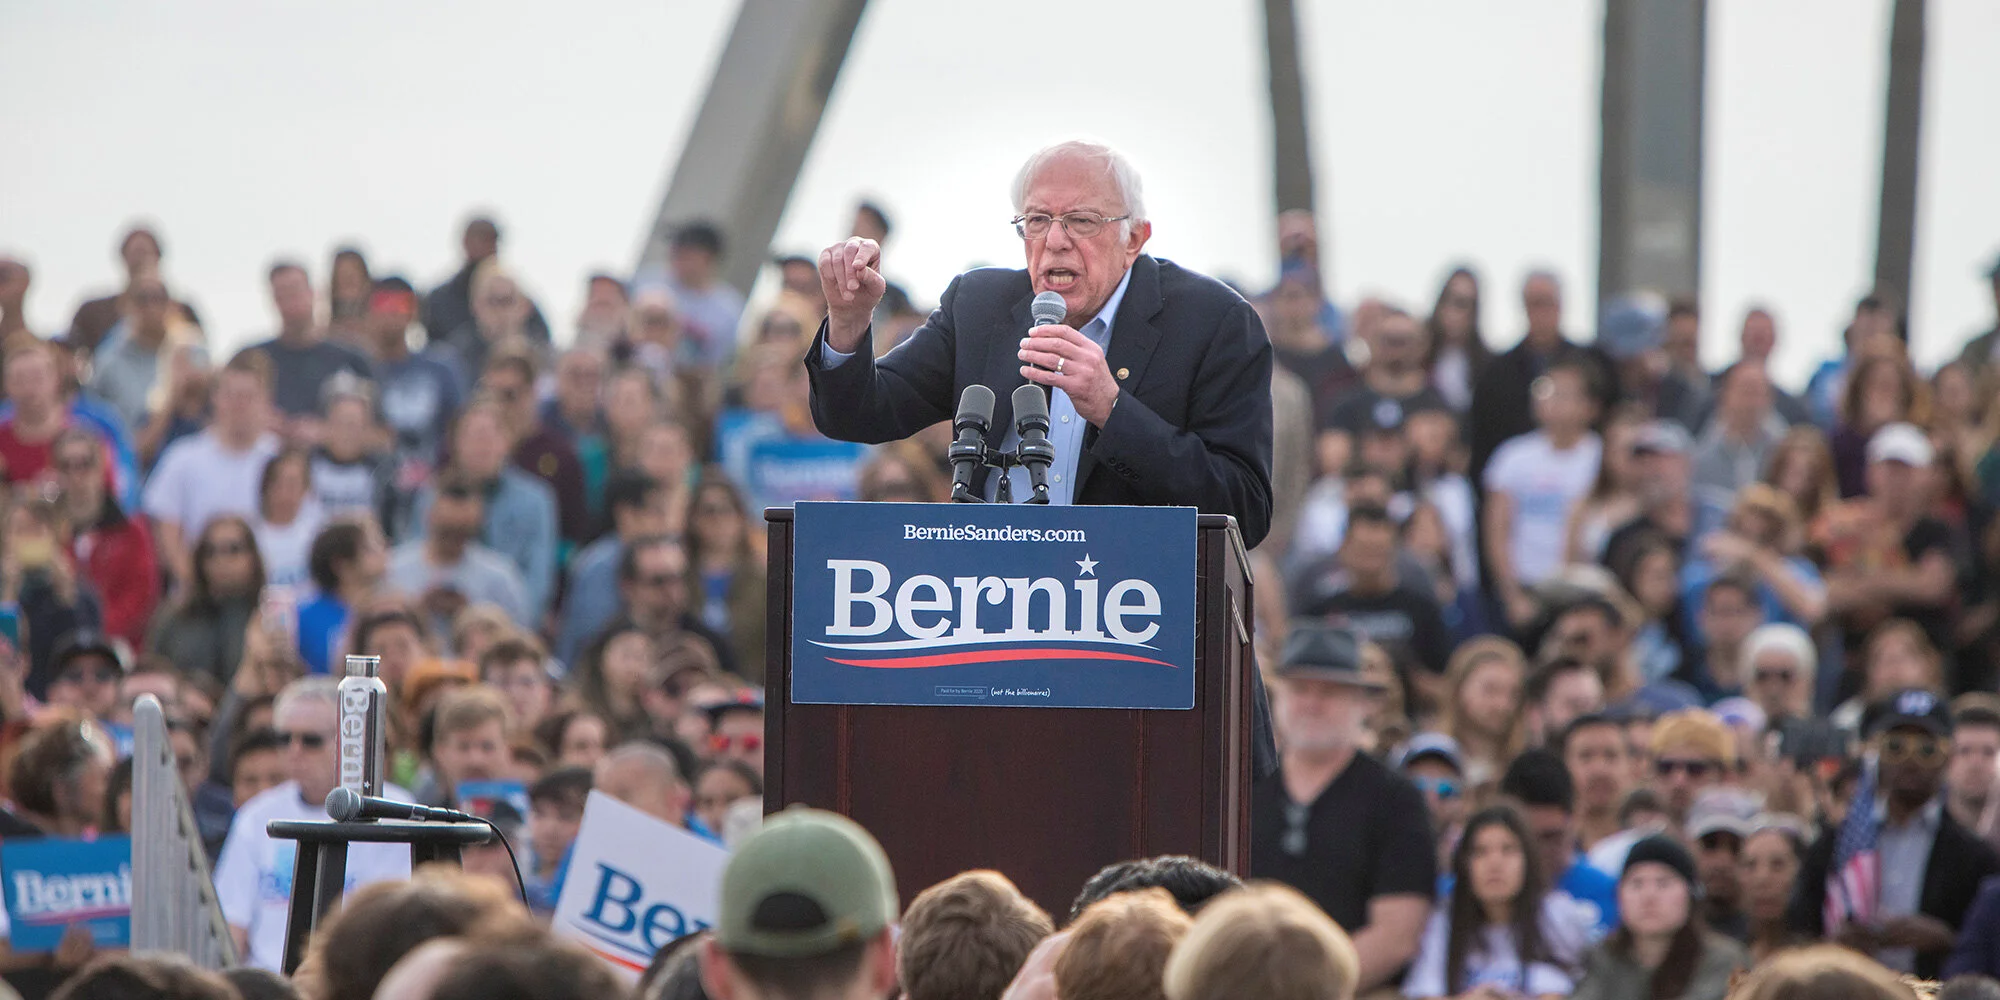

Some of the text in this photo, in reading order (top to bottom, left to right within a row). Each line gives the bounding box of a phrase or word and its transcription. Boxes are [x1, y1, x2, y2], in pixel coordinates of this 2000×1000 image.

[903, 524, 1086, 543] BernieSanders.com
[825, 553, 1162, 644] Bernie
[990, 687, 1051, 698] (not the billionaires)
[580, 860, 712, 951] Be
